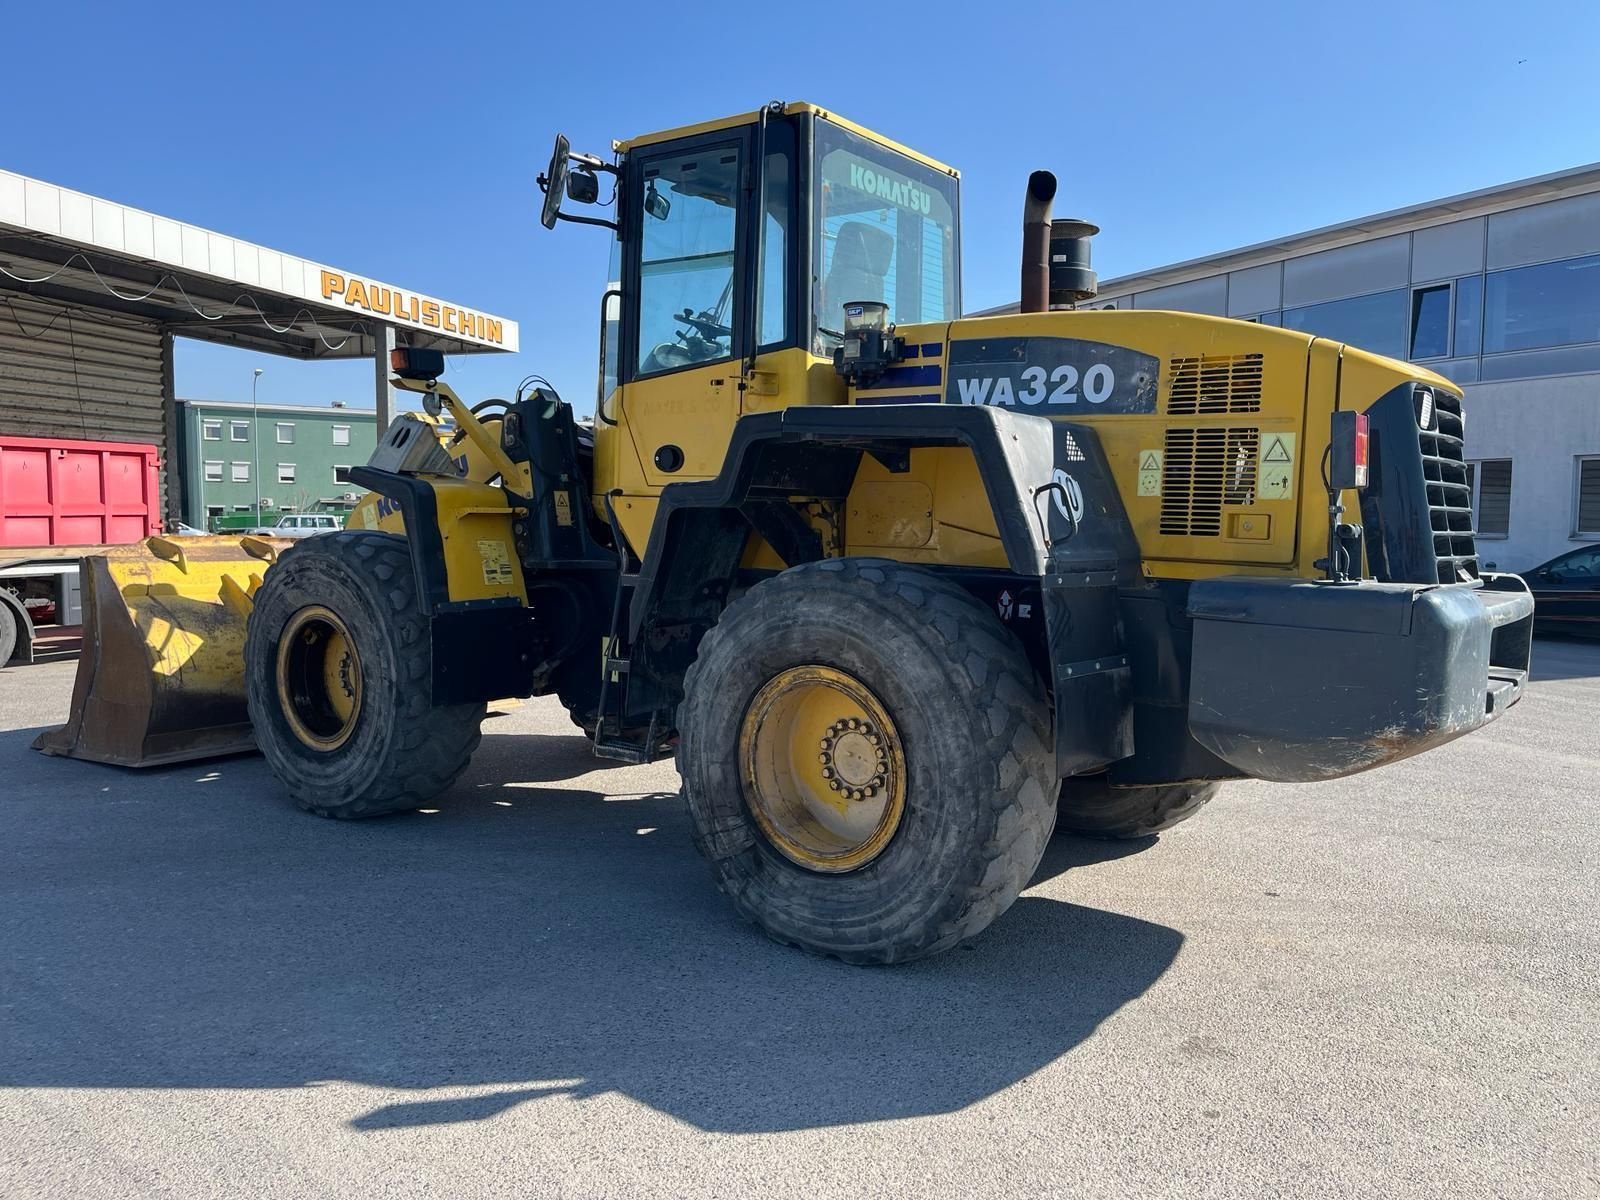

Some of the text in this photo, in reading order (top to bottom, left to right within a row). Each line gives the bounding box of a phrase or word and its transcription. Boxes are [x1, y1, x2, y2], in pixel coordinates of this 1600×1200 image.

[850, 163, 931, 215] KOMATSU
[320, 270, 503, 344] PAULISCHIN
[957, 363, 1115, 406] WA320
